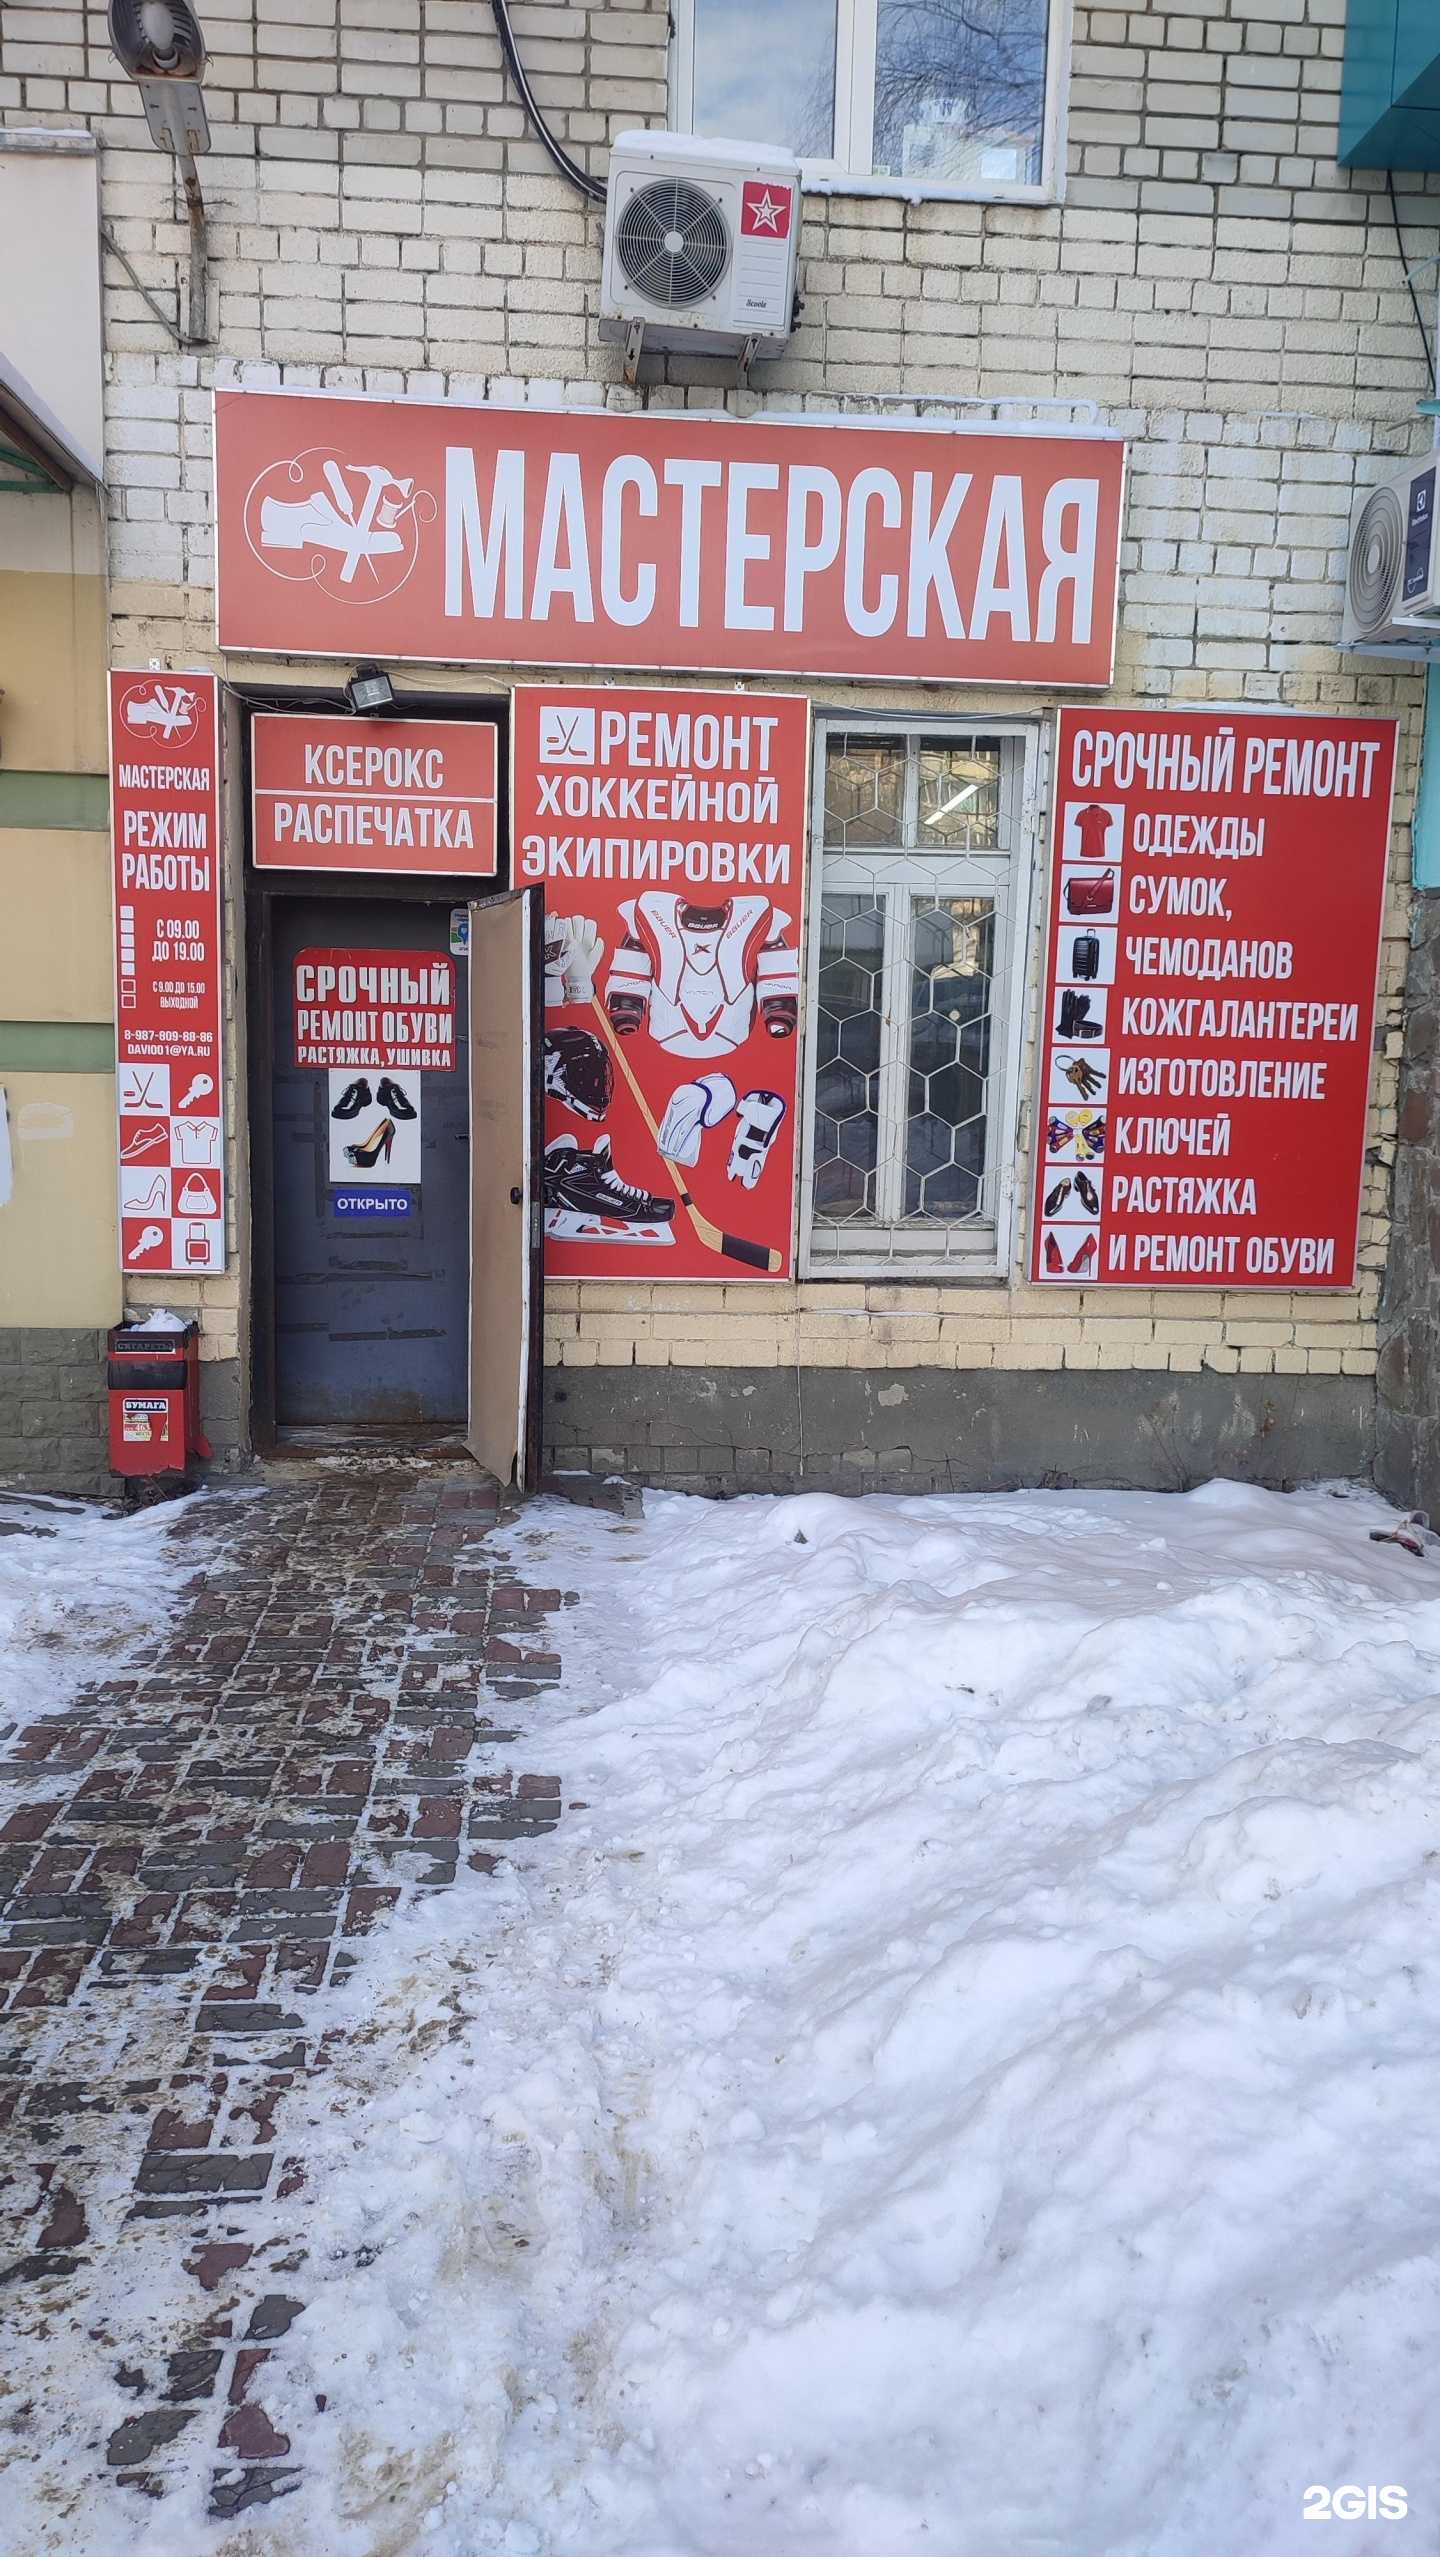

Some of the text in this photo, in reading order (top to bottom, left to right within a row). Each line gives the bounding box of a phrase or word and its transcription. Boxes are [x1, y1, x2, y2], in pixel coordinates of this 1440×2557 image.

[444, 446, 1100, 645] МАСТЕРСКАЯ
[600, 710, 778, 771] РЕМОНТ
[119, 764, 210, 791] МАСТЕРСКАЯ
[304, 744, 444, 789] КСЕРОКС
[1072, 727, 1380, 798] СРОЧНЫЙ РЕМОНТ
[535, 773, 779, 824] ХОККЕЙНОЙ
[123, 810, 207, 849] РЕЖИМ
[274, 802, 474, 849] РАСПЕЧАТКА
[1133, 813, 1265, 860] ОДЕЖДЫ
[121, 853, 210, 891] РАБОТЫ
[521, 835, 790, 885] ЭКИПИРОВКИ
[1128, 874, 1232, 922] СУМОК,
[156, 919, 199, 939] С 09.00
[152, 941, 205, 962] ДО 19.00
[1125, 936, 1293, 981] ЧЕМОДАНОВ
[160, 996, 199, 1009] ВЫХОДНОЙ
[174, 982, 185, 995] ДО
[296, 962, 450, 1006] СРОЧНЫЙ
[297, 1009, 452, 1044] РЕМОНТ ОБУВИ
[1121, 997, 1359, 1042] КОЖГАЛАНТЕРЕИ
[297, 1046, 451, 1068] РАСТЯЖКА, УШИВКА
[1118, 1057, 1327, 1100] ИЗГОТОВЛЕНИЕ
[1114, 1113, 1231, 1157] КЛЮЧЕЙ
[337, 1197, 408, 1211] ОТКРЫТО
[1111, 1175, 1257, 1216] РАСТЯЖКА
[1108, 1234, 1334, 1275] И РЕМОНТ ОБУВИ
[125, 1401, 166, 1410] БУМАГА
